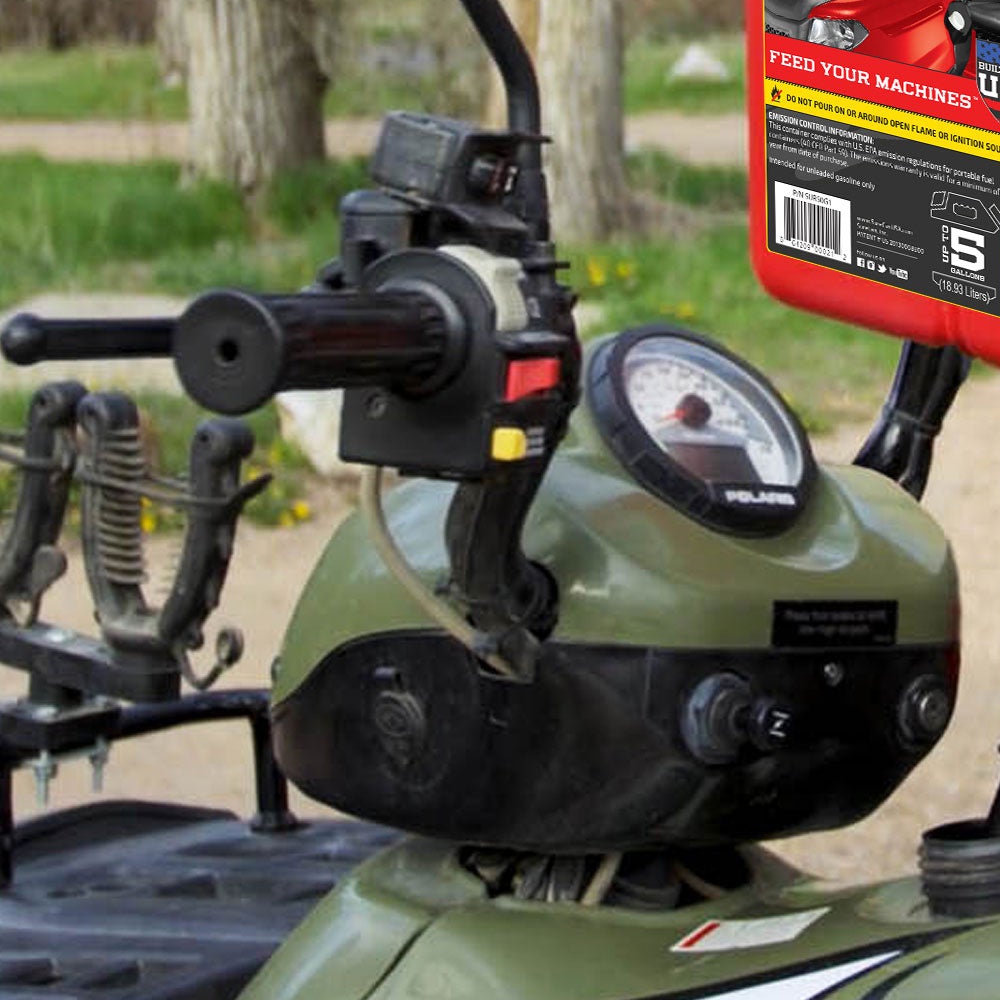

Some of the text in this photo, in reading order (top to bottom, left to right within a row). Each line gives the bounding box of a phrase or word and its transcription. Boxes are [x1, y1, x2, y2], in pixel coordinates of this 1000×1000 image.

[769, 49, 972, 109] FEED YOUR MACHINES
[768, 111, 875, 145] EMISSION CONTROL INFORMATION:
[786, 94, 797, 103] DO
[797, 96, 812, 107] NOT
[813, 100, 834, 111] POUR
[834, 105, 846, 115] ON
[846, 108, 857, 118] OR
[858, 111, 889, 125] AROUND
[889, 119, 910, 131] OPEN
[911, 124, 937, 138] FLAME
[938, 130, 949, 141] OR
[950, 133, 985, 149] IGNITION
[768, 120, 782, 131] This
[782, 124, 811, 139] container
[811, 131, 838, 146] complies
[838, 137, 853, 149] with
[853, 141, 865, 152] U.S.
[865, 145, 877, 156] EPA
[878, 150, 906, 163] emission
[906, 155, 942, 172] regulations
[942, 164, 953, 174] for
[953, 168, 981, 182] portable
[768, 141, 849, 168] year from date of purchase.
[796, 160, 806, 172] for
[806, 165, 835, 180] unleaded
[835, 173, 861, 188] gasoline
[861, 181, 876, 192] only
[850, 151, 862, 160] The
[894, 163, 922, 178] warranty
[929, 171, 945, 182] valid
[946, 175, 956, 184] for
[961, 180, 993, 194] minimum
[792, 189, 804, 199] P/N
[842, 253, 848, 261] 2
[941, 225, 950, 263] UP TO
[950, 226, 985, 272] 5
[939, 278, 991, 305] (18.93 Liters)
[950, 267, 985, 282] GALLONS
